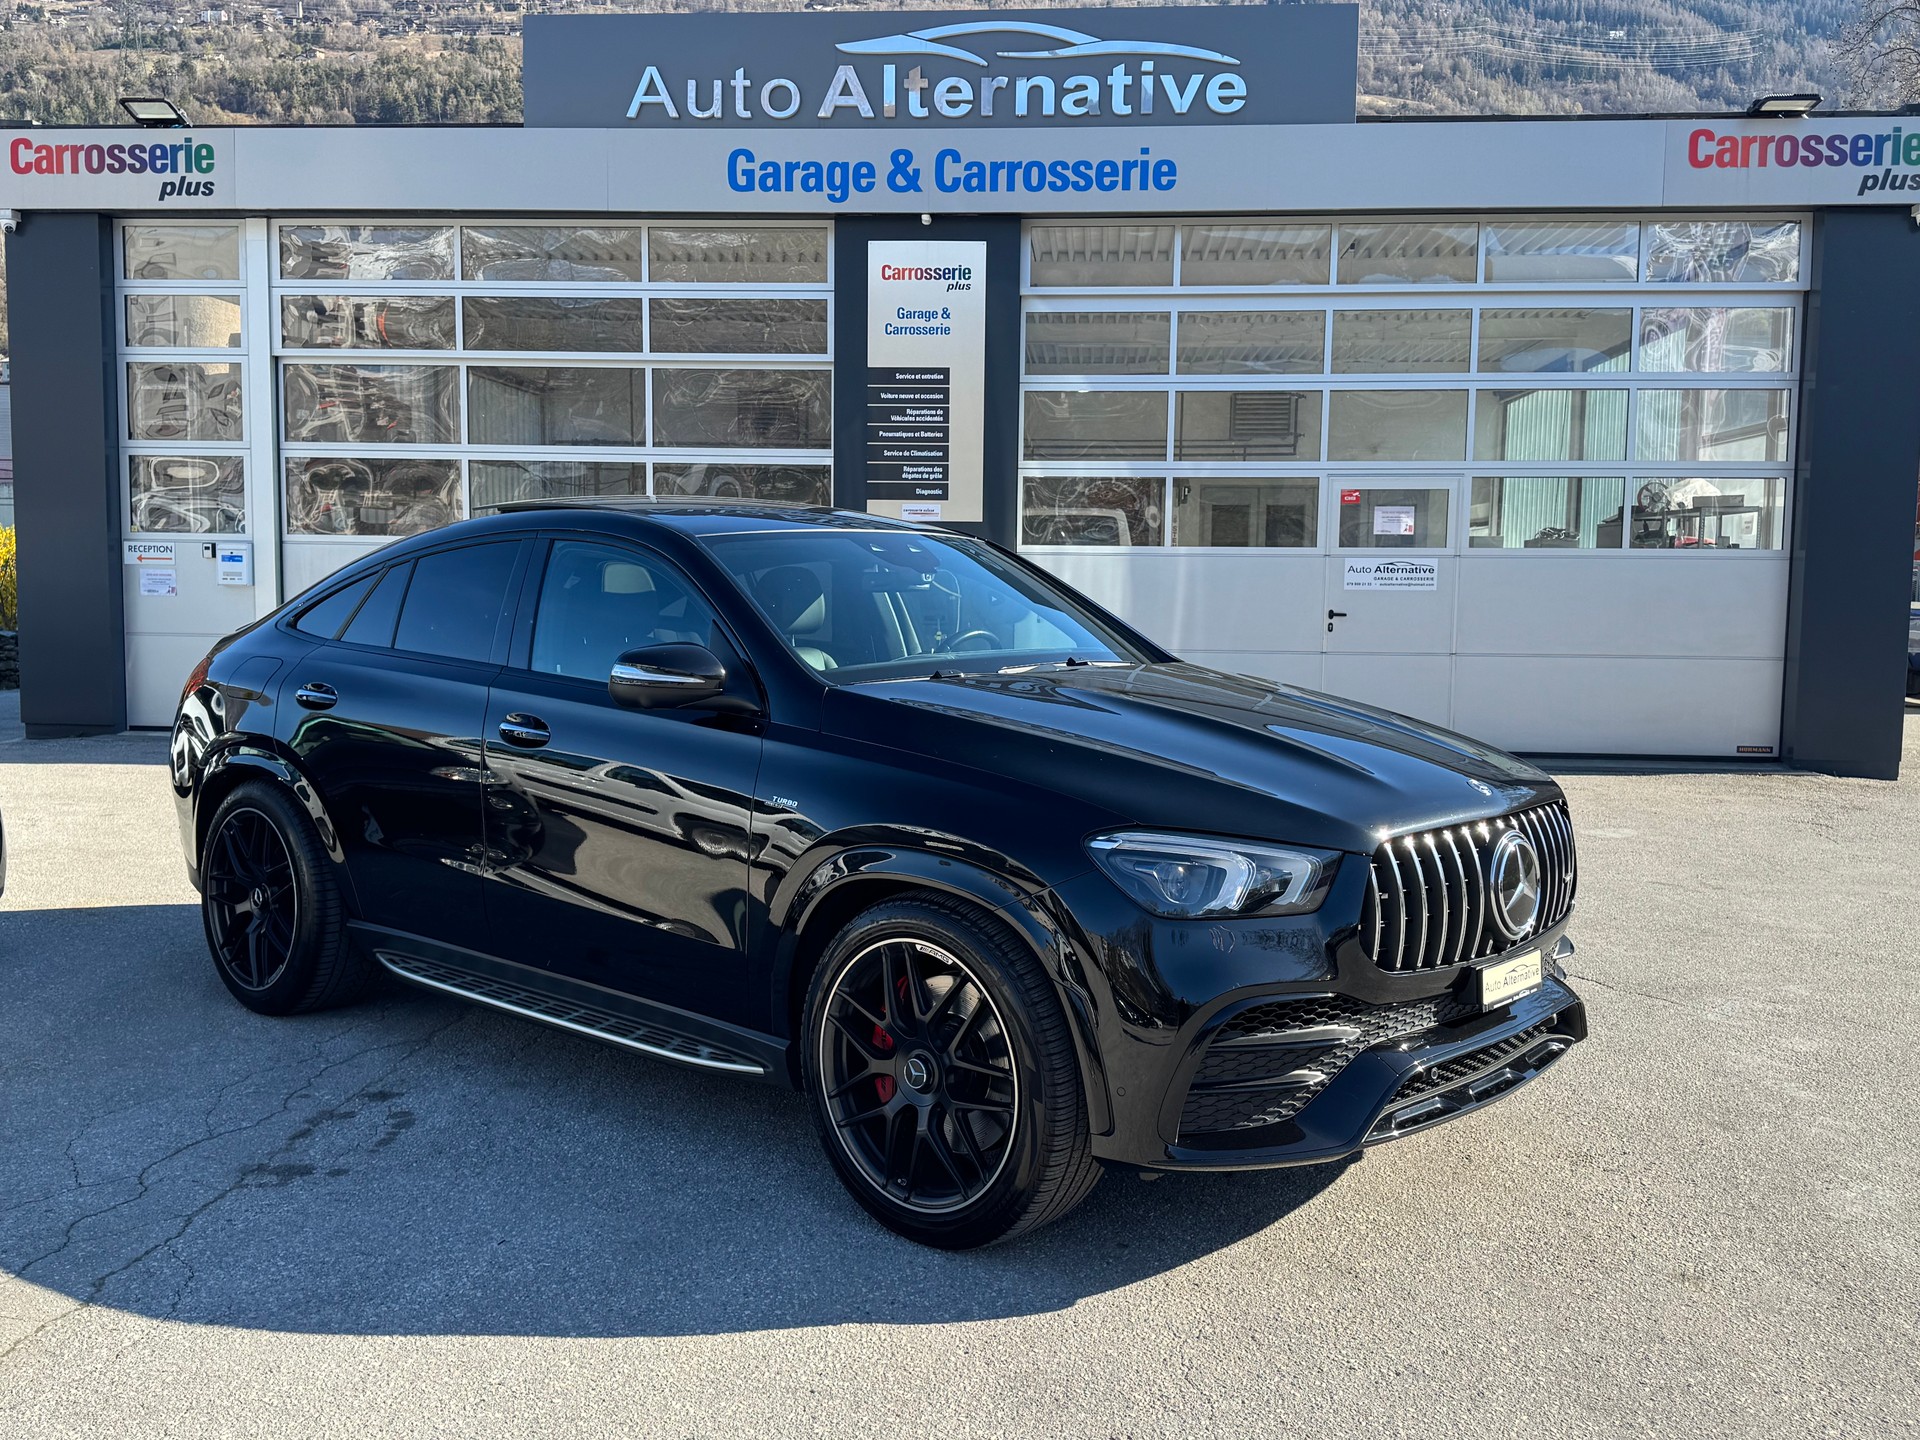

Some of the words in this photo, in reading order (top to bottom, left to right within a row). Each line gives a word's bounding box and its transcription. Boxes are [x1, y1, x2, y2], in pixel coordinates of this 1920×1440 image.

[626, 65, 800, 119] Auto
[817, 59, 1248, 119] Alternative
[10, 136, 216, 175] Carrosserie
[1687, 126, 1920, 169] Carrosserie
[727, 147, 877, 204] Garage
[886, 148, 923, 194] &
[934, 146, 1178, 193] Carrosserie
[1857, 168, 1920, 196] plus
[158, 175, 216, 201] plus
[881, 264, 972, 281] Carrosserie
[946, 281, 972, 292] plus
[896, 306, 938, 322] Garage
[941, 307, 951, 320] &
[885, 323, 951, 335] Carrosserie
[906, 408, 936, 416] Réparations
[879, 430, 914, 438] Pneumatiques
[903, 465, 933, 473] Réparations
[128, 544, 173, 554] RECEPTION
[1347, 565, 1372, 574] Auto
[1374, 565, 1435, 574] Alternative
[772, 795, 798, 807] TURBO
[1484, 980, 1502, 993] Auto
[1503, 967, 1539, 987] Alternative
